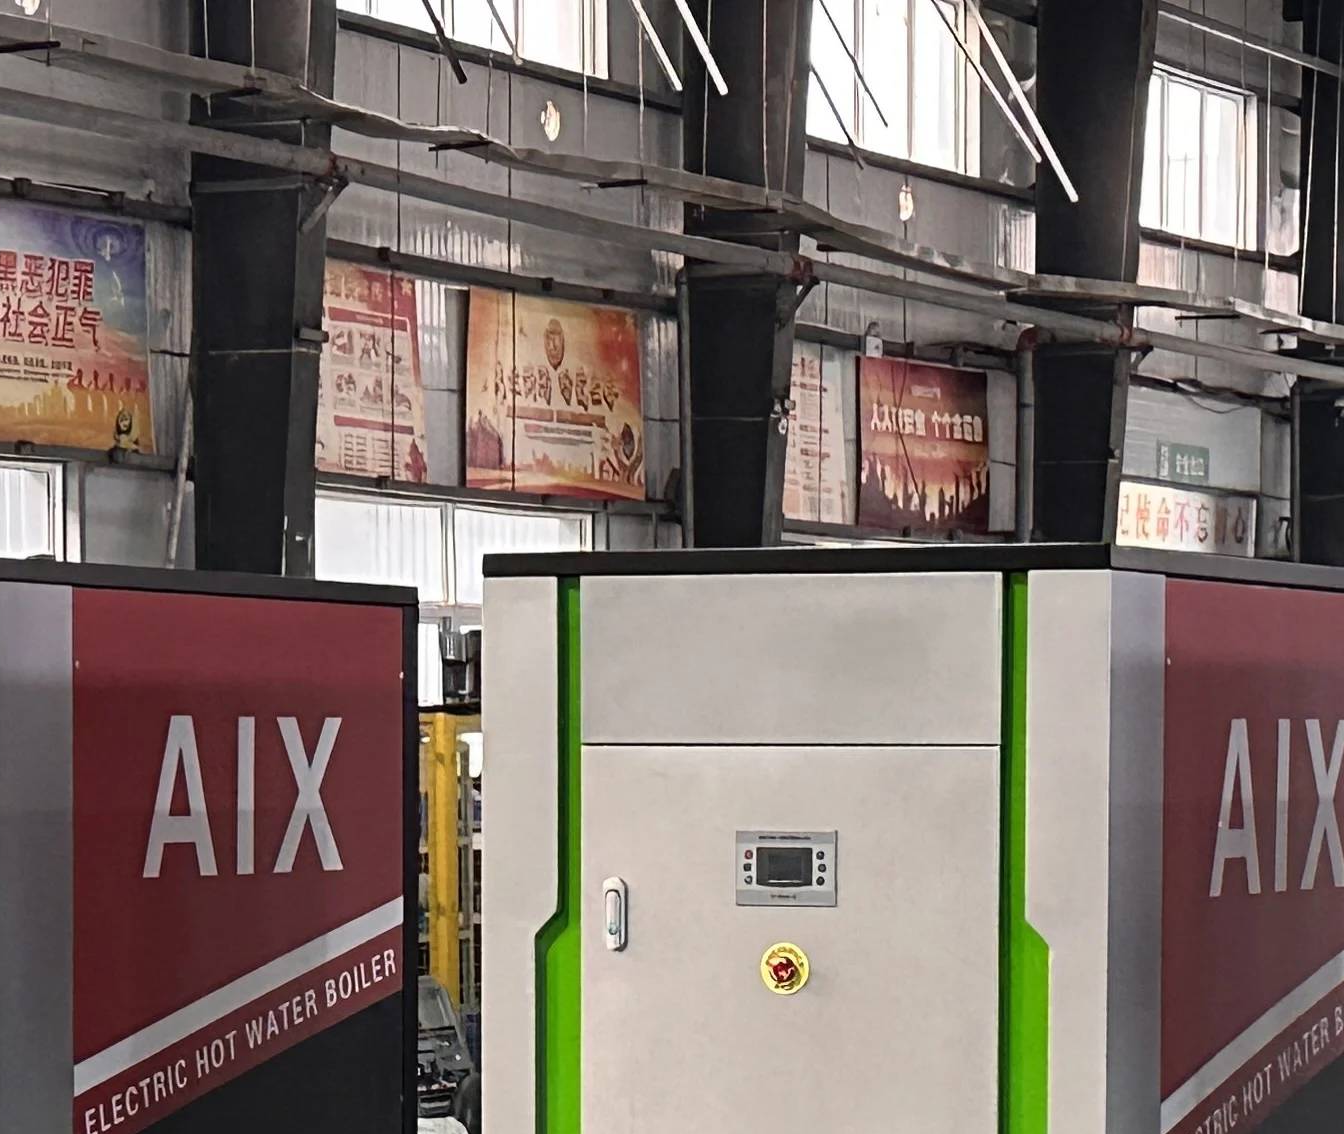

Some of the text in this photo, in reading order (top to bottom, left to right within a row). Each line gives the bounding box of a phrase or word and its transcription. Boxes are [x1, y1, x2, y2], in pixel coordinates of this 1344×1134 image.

[143, 715, 343, 878] AIX
[195, 1030, 238, 1079] HOT
[245, 989, 318, 1049] WATER
[325, 949, 397, 1007] BOILER
[1242, 1063, 1272, 1116] HOT
[1277, 1016, 1330, 1082] WATER
